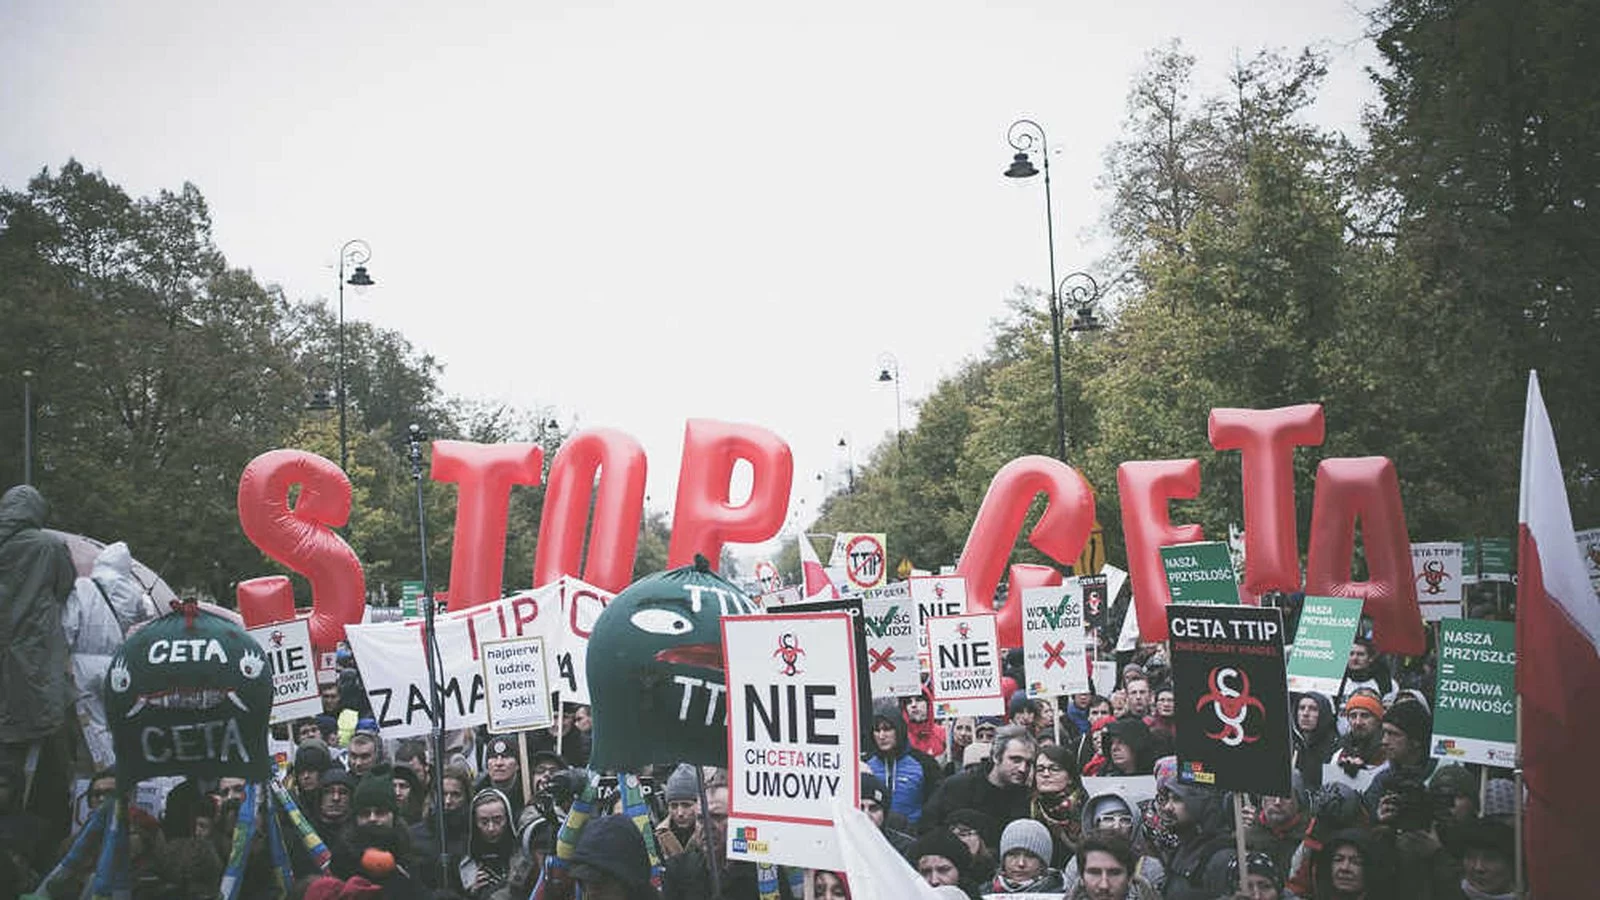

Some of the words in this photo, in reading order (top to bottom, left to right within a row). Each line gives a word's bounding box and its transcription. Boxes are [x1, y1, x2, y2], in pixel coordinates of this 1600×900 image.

[237, 418, 794, 655] STOP
[851, 552, 882, 576] TTIP
[1165, 556, 1198, 569] NASZA
[1027, 619, 1046, 631] DLA
[1171, 617, 1227, 639] CETA
[1228, 620, 1278, 641] TTIP
[1444, 630, 1493, 646] NASZA
[148, 638, 229, 665] CETA
[487, 644, 539, 660] najpierw
[939, 642, 992, 669] NIE
[498, 679, 536, 694] potem
[941, 677, 993, 692] UMOWY
[1440, 679, 1502, 696] ZDROWA
[501, 693, 536, 711] zyski!
[1439, 693, 1513, 714] ŻYWNOŚĆ
[744, 684, 840, 745] NIE
[140, 717, 250, 763] CETA
[744, 748, 841, 771] CHCETAKIEJ
[745, 770, 841, 800] UMOWY
